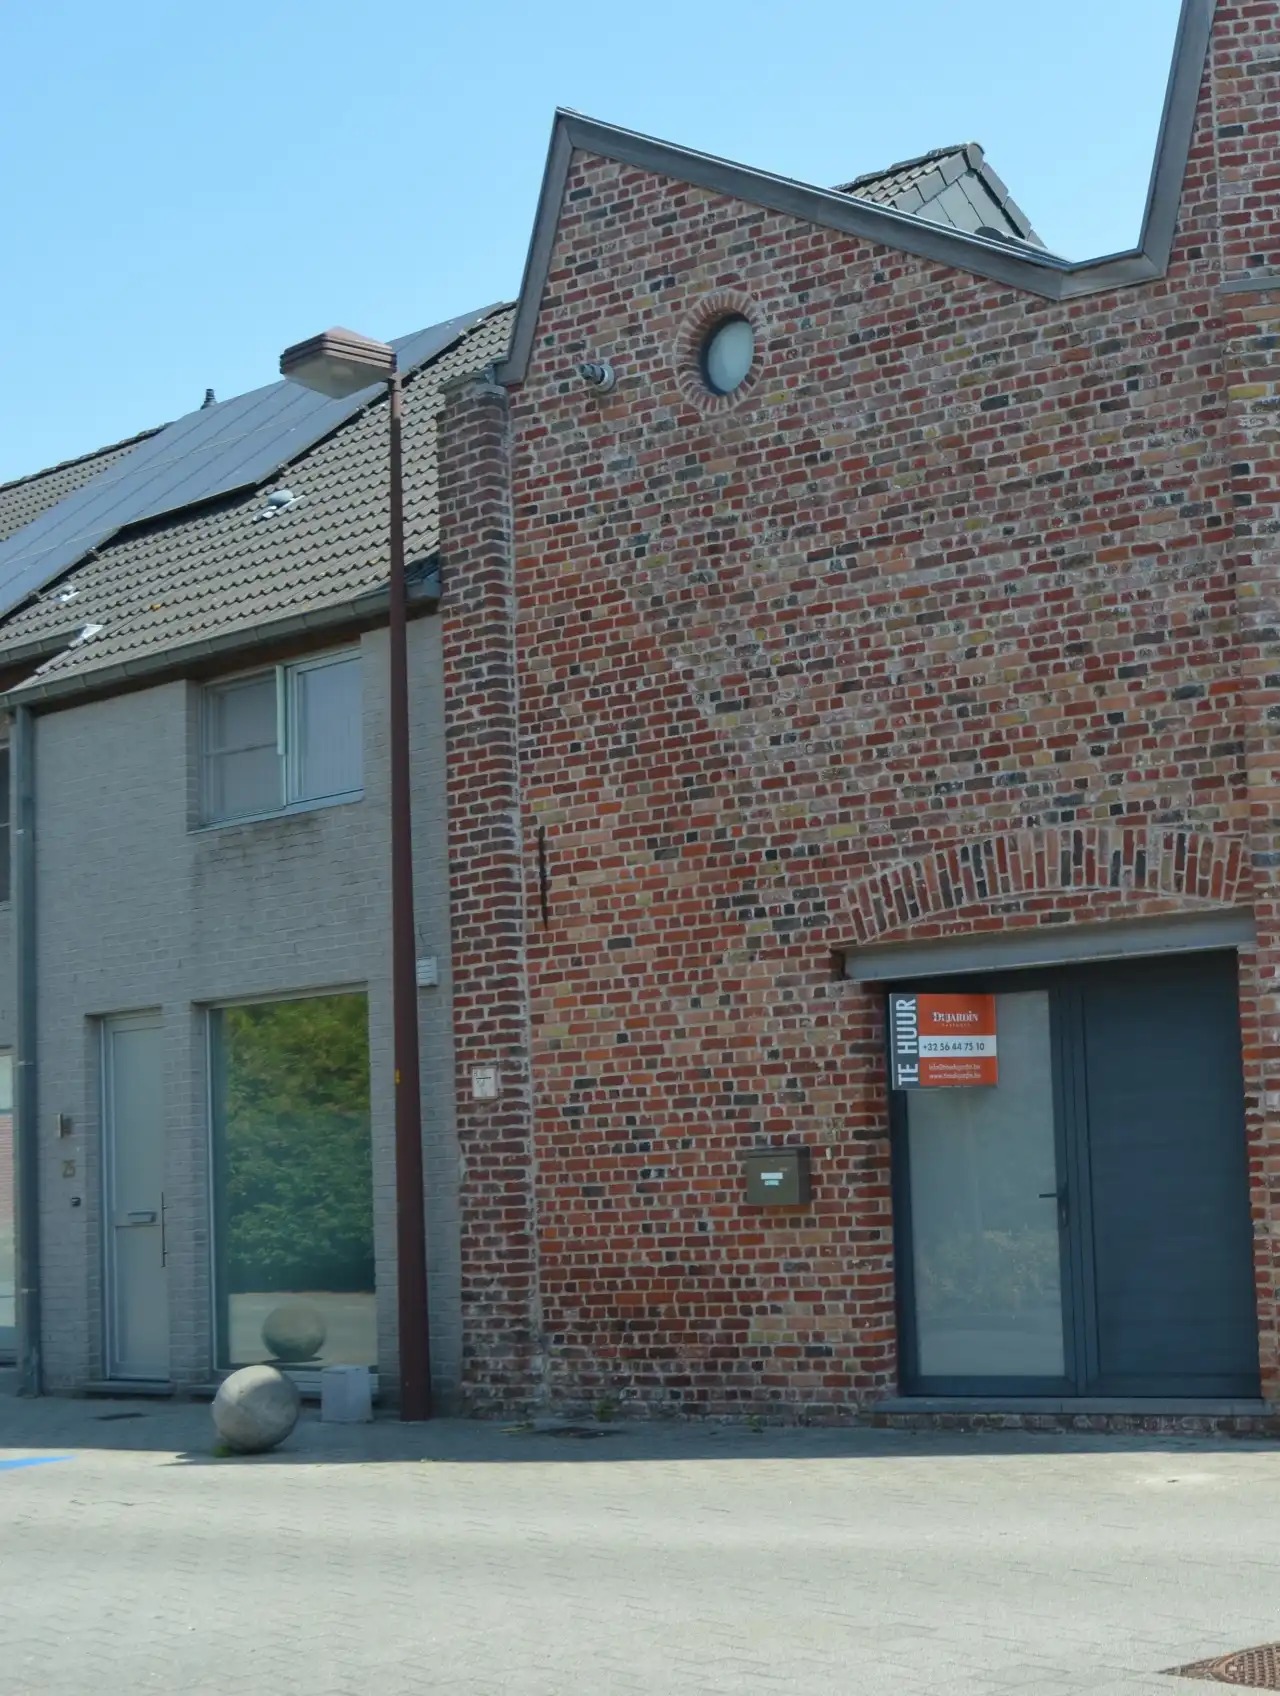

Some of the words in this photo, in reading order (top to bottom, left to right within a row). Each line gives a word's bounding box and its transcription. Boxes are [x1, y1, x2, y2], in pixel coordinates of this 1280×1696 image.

[895, 998, 918, 1054] HUUR
[922, 1042, 938, 1051] +32
[939, 1042, 950, 1051] 56
[952, 1042, 962, 1051] 44
[964, 1042, 974, 1051] 75
[976, 1042, 985, 1051] 10
[898, 1063, 919, 1086] TE
